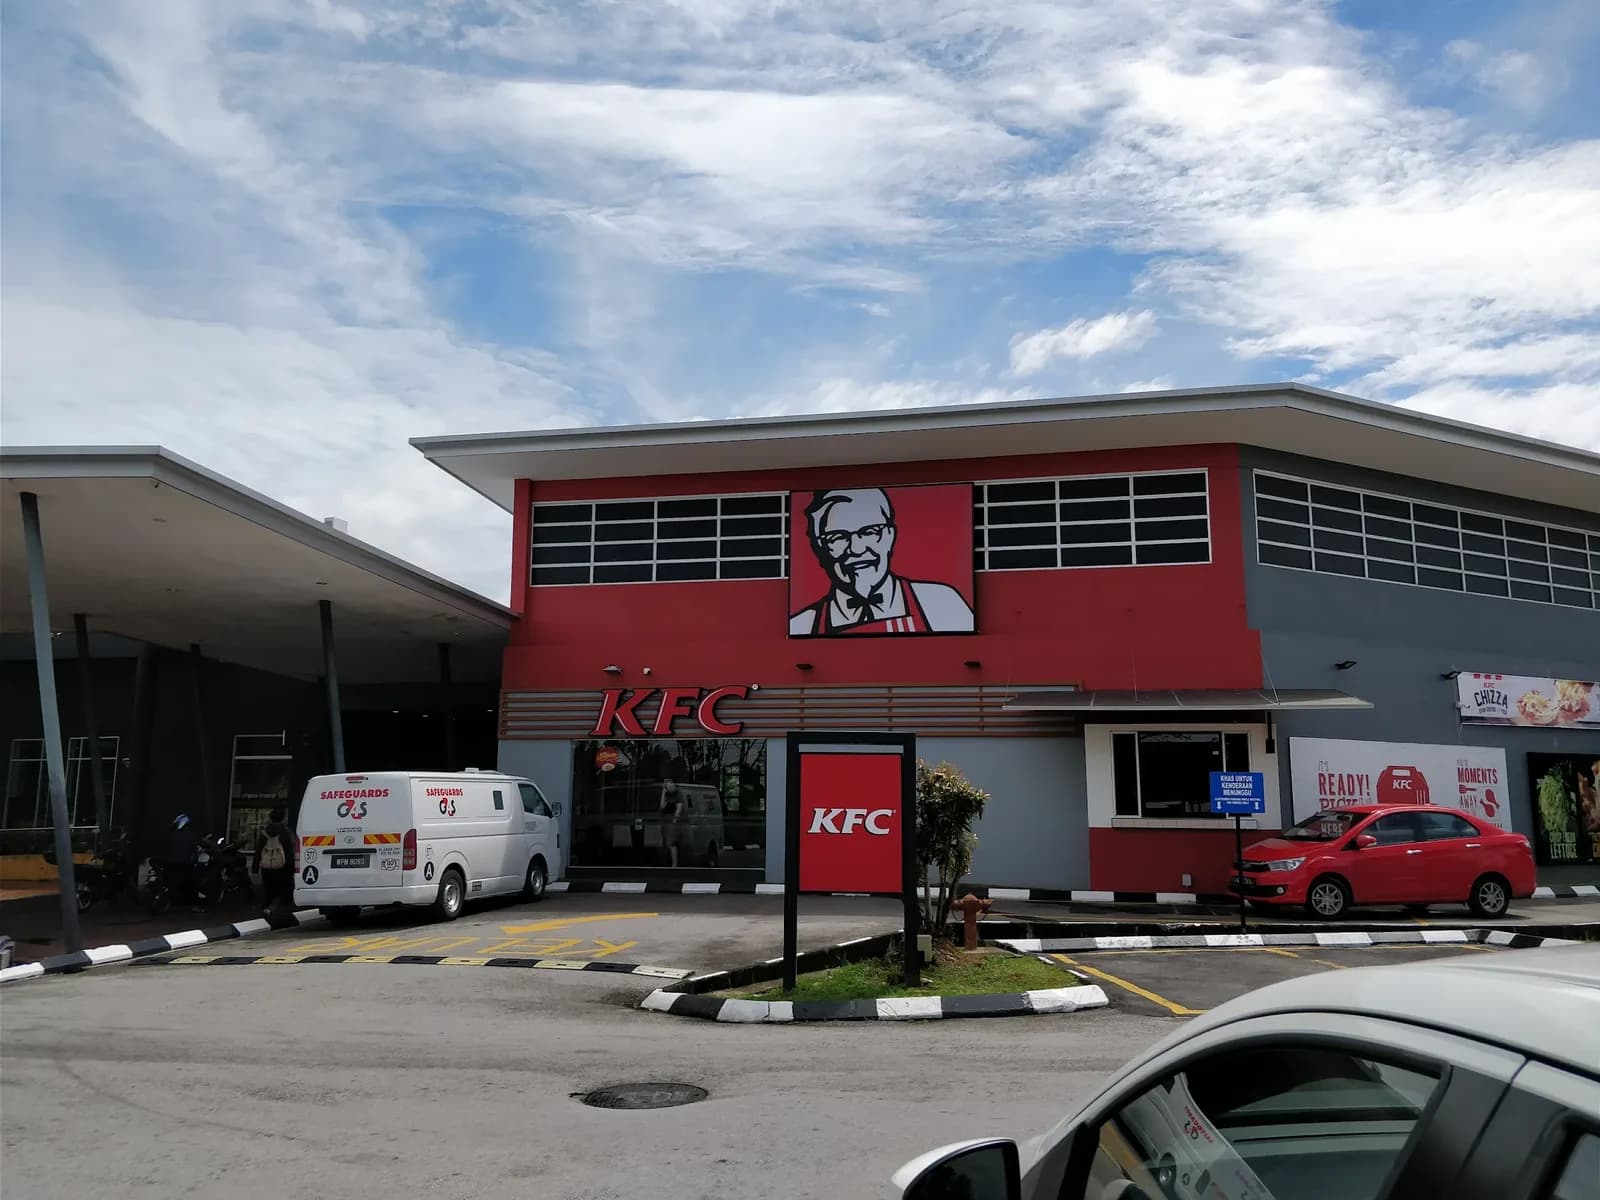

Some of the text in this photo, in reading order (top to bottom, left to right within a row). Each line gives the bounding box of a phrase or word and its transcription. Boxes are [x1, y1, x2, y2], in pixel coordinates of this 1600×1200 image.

[1474, 689, 1508, 709] CHIZZA
[588, 686, 746, 736] KFC
[1318, 772, 1370, 796] READY!
[1392, 779, 1413, 790] KFC
[1457, 767, 1498, 784] MOMENTS
[320, 789, 389, 800] SAFEGUARDS
[426, 788, 463, 797] SAFEGUARDS
[807, 807, 893, 835] KFC
[305, 867, 316, 882] A
[286, 936, 639, 957] KELUAR
